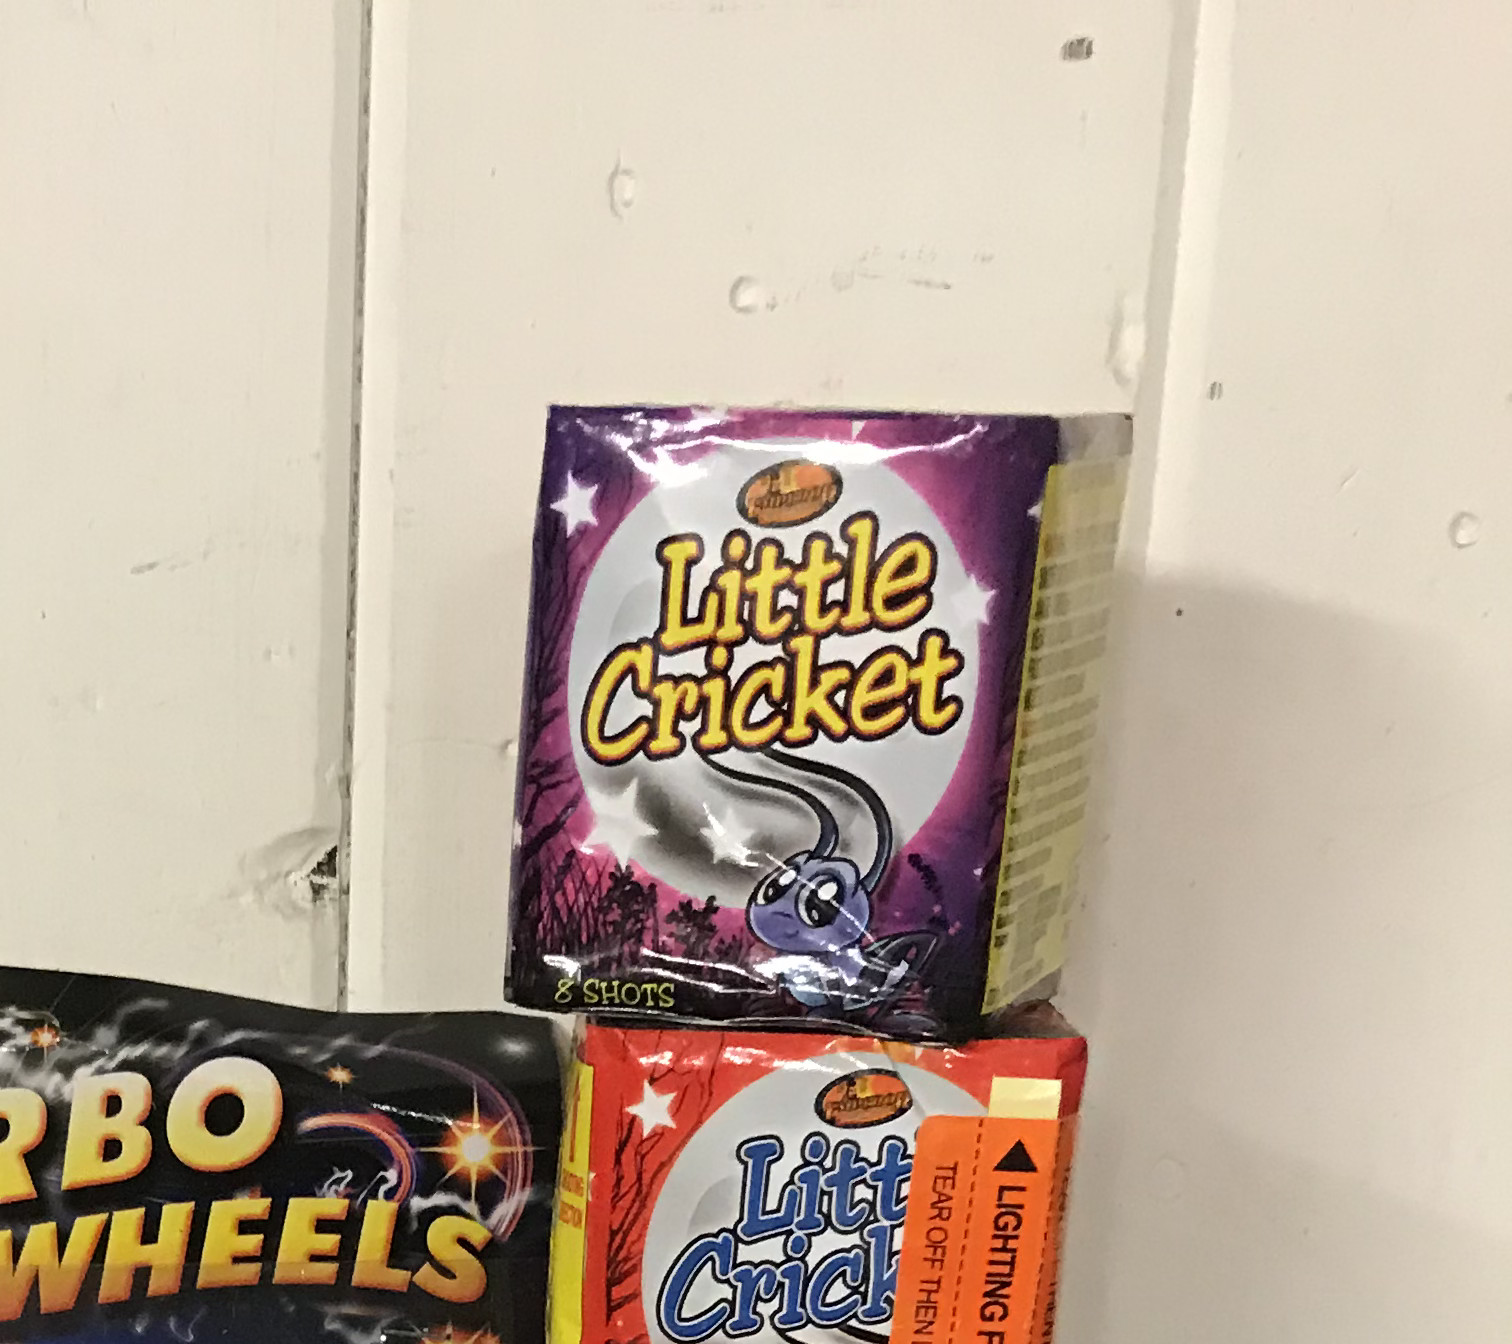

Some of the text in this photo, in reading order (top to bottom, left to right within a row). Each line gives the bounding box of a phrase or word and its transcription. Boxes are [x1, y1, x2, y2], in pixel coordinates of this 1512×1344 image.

[656, 511, 938, 653] Little
[582, 628, 965, 766] Cricket
[554, 978, 675, 1007] 8 SHOTS
[736, 1131, 915, 1244] Litt
[928, 1160, 959, 1224] TEAR
[922, 1228, 949, 1273] OFF
[982, 1185, 1026, 1322] LIGHTING
[913, 1279, 944, 1337] THEN
